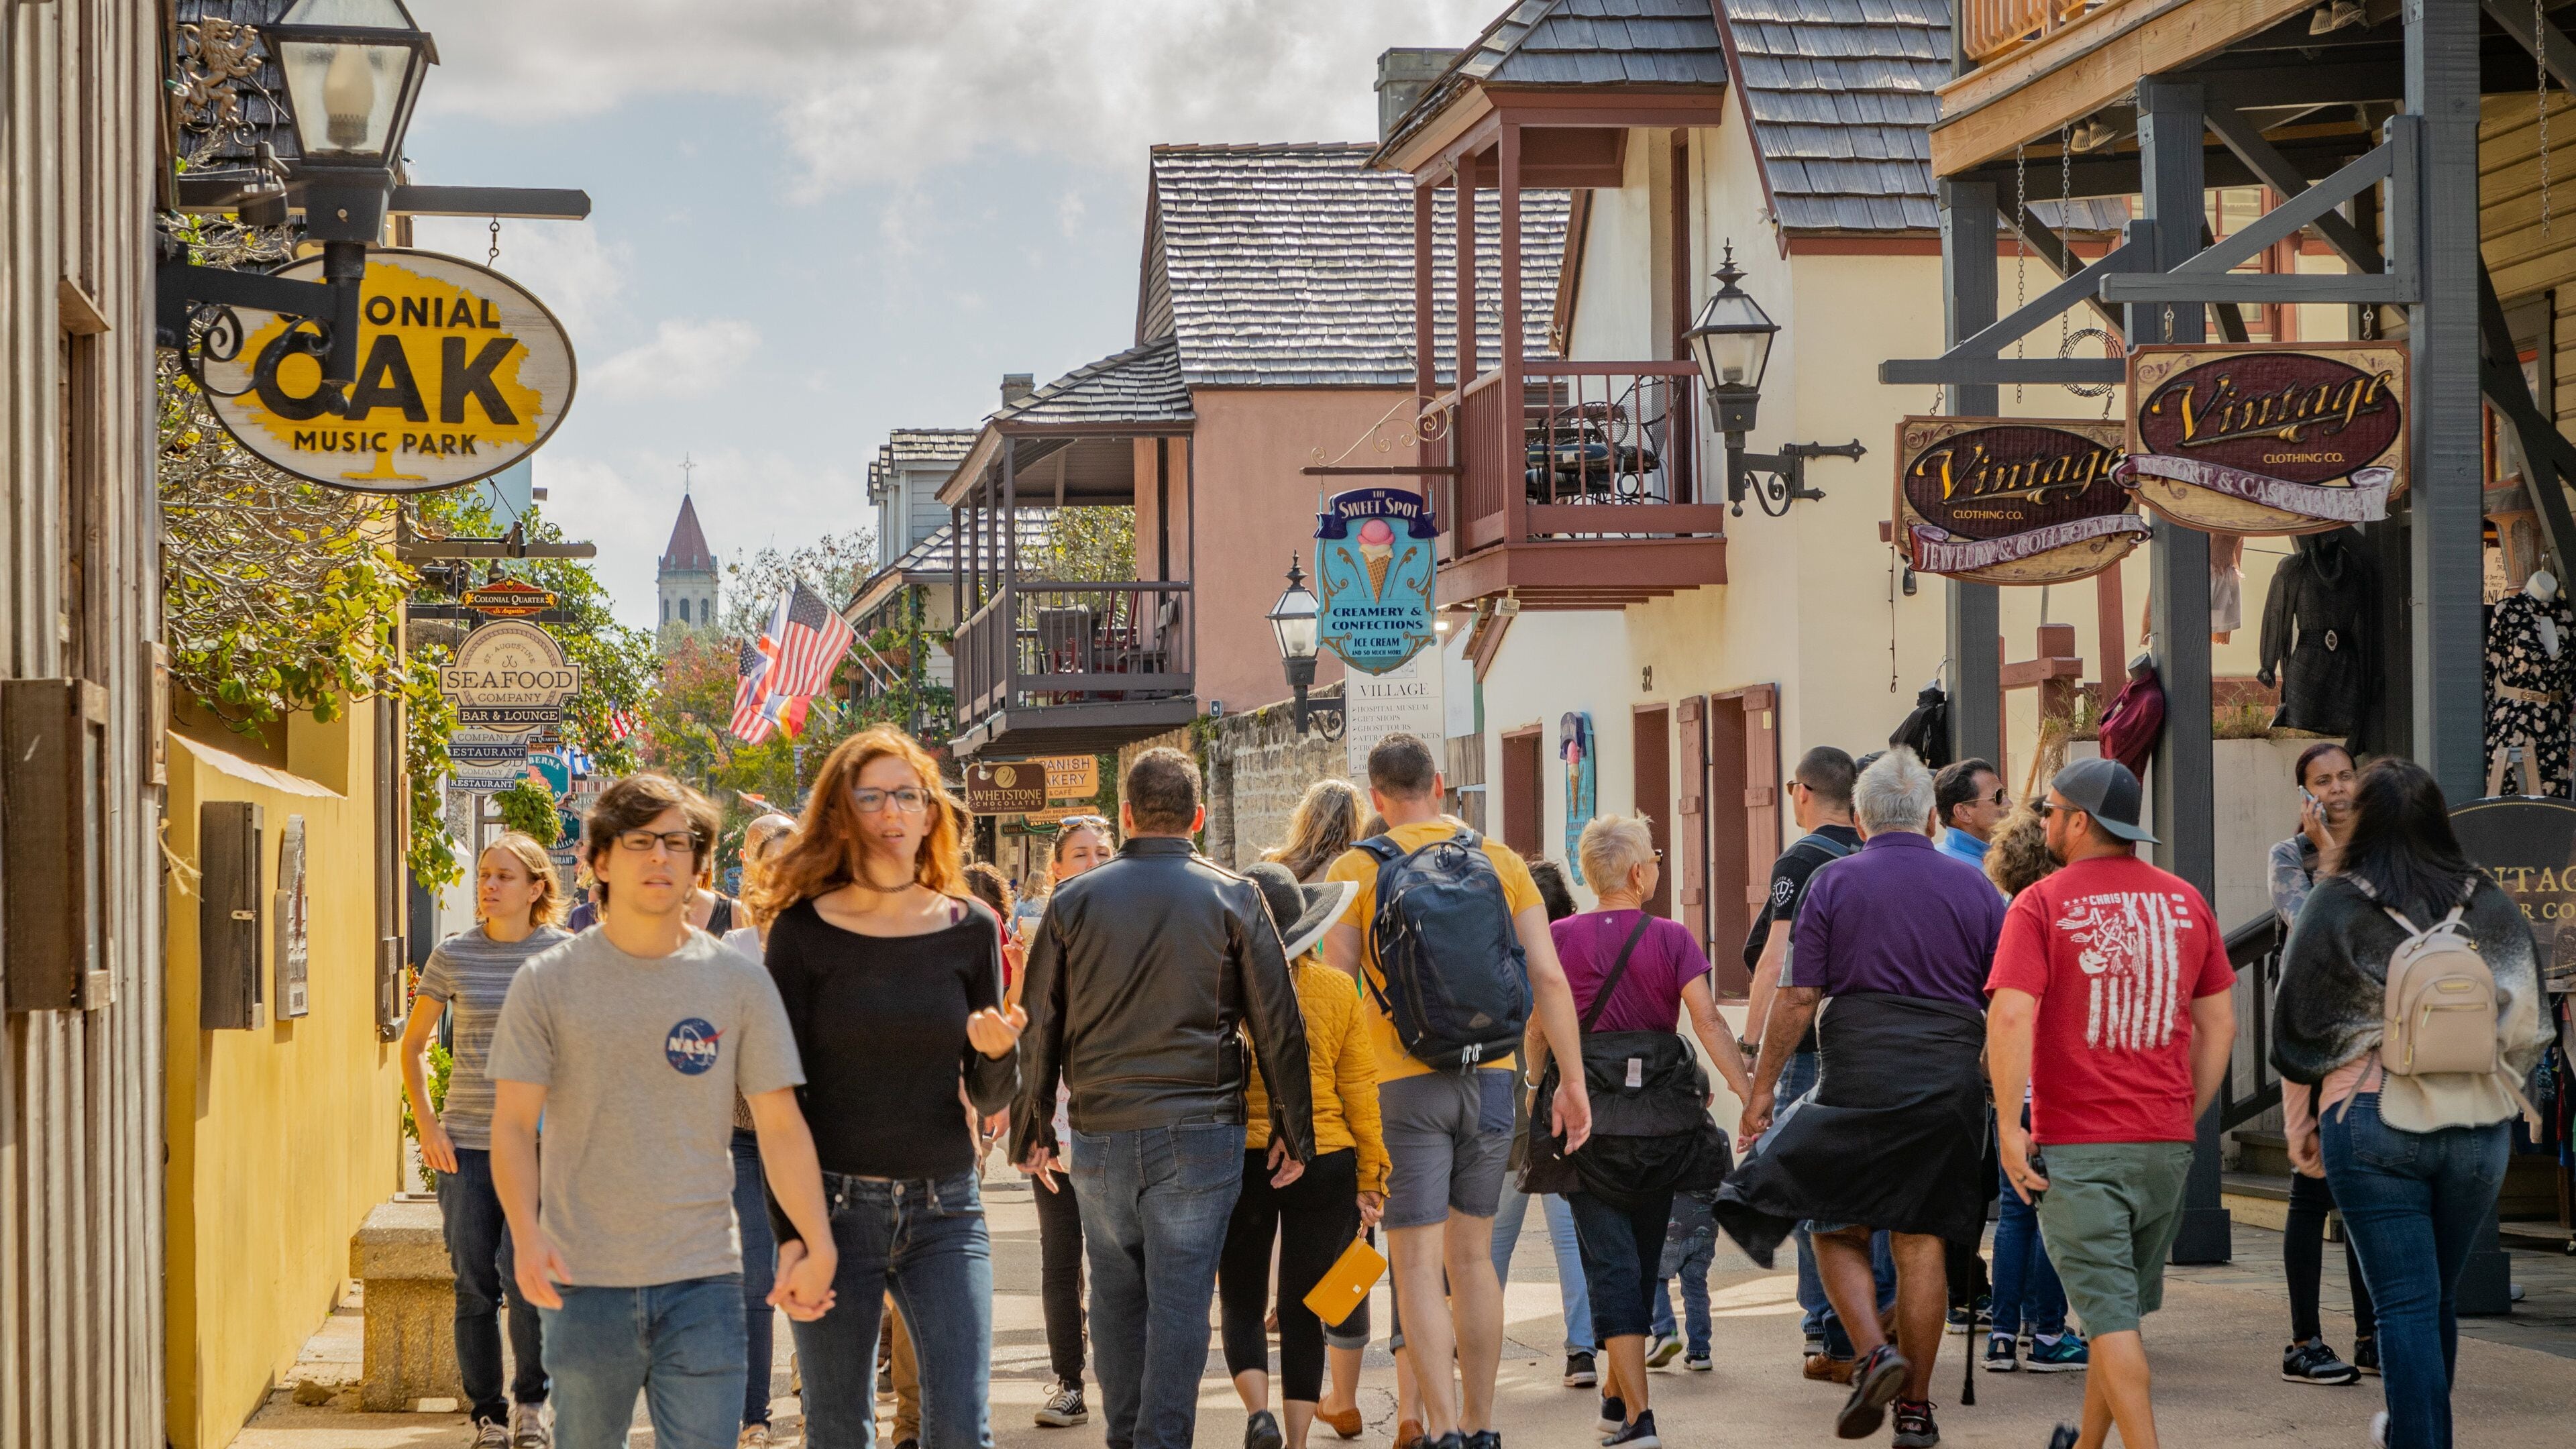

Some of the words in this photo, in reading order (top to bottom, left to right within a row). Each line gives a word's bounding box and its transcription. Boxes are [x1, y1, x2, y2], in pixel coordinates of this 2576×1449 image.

[254, 333, 519, 425] OAK
[2151, 370, 2394, 441] Vintage
[294, 431, 388, 453] MUSIC
[402, 433, 477, 455] PARK
[2263, 453, 2322, 464] CLOTHING
[2324, 452, 2345, 463] CO.
[1916, 442, 2126, 501] Vintage
[2217, 471, 2233, 490] &
[1338, 500, 1381, 519] SWEET
[1385, 497, 1419, 518] SPOT
[1953, 509, 2004, 519] CLOTHING
[2006, 511, 2024, 520] CO.
[1921, 542, 1994, 571] JEWELRY
[1998, 540, 2014, 561] &
[474, 595, 510, 603] COLONIAL
[511, 595, 545, 605] QUARTER
[1333, 606, 1405, 617] CREAMERY
[1410, 606, 1422, 616] &
[1332, 620, 1424, 631] CONFECTIONS
[1354, 638, 1367, 647] ICE
[1370, 637, 1399, 647] CREAM
[494, 643, 535, 664] AUGUSTINE
[447, 671, 572, 688] SEAFOOD
[1642, 665, 1652, 692] 32
[1360, 682, 1429, 696] VILLAGE
[478, 694, 541, 702] COMPANY
[1357, 704, 1394, 712] HOSPITAL
[462, 712, 488, 720] BAR
[493, 712, 500, 720] &
[505, 710, 558, 720] LOUNGE
[458, 733, 510, 741] COMPANY
[529, 756, 560, 770] BERNA
[1042, 758, 1089, 771] PANISH
[451, 779, 513, 789] RESTAURANT
[973, 788, 1042, 801] WHETSTONE
[1055, 788, 1072, 796] CAFÉ
[2479, 866, 2576, 893] NTAG
[2089, 893, 2121, 906] CHRIS
[669, 1036, 717, 1056] NASA
